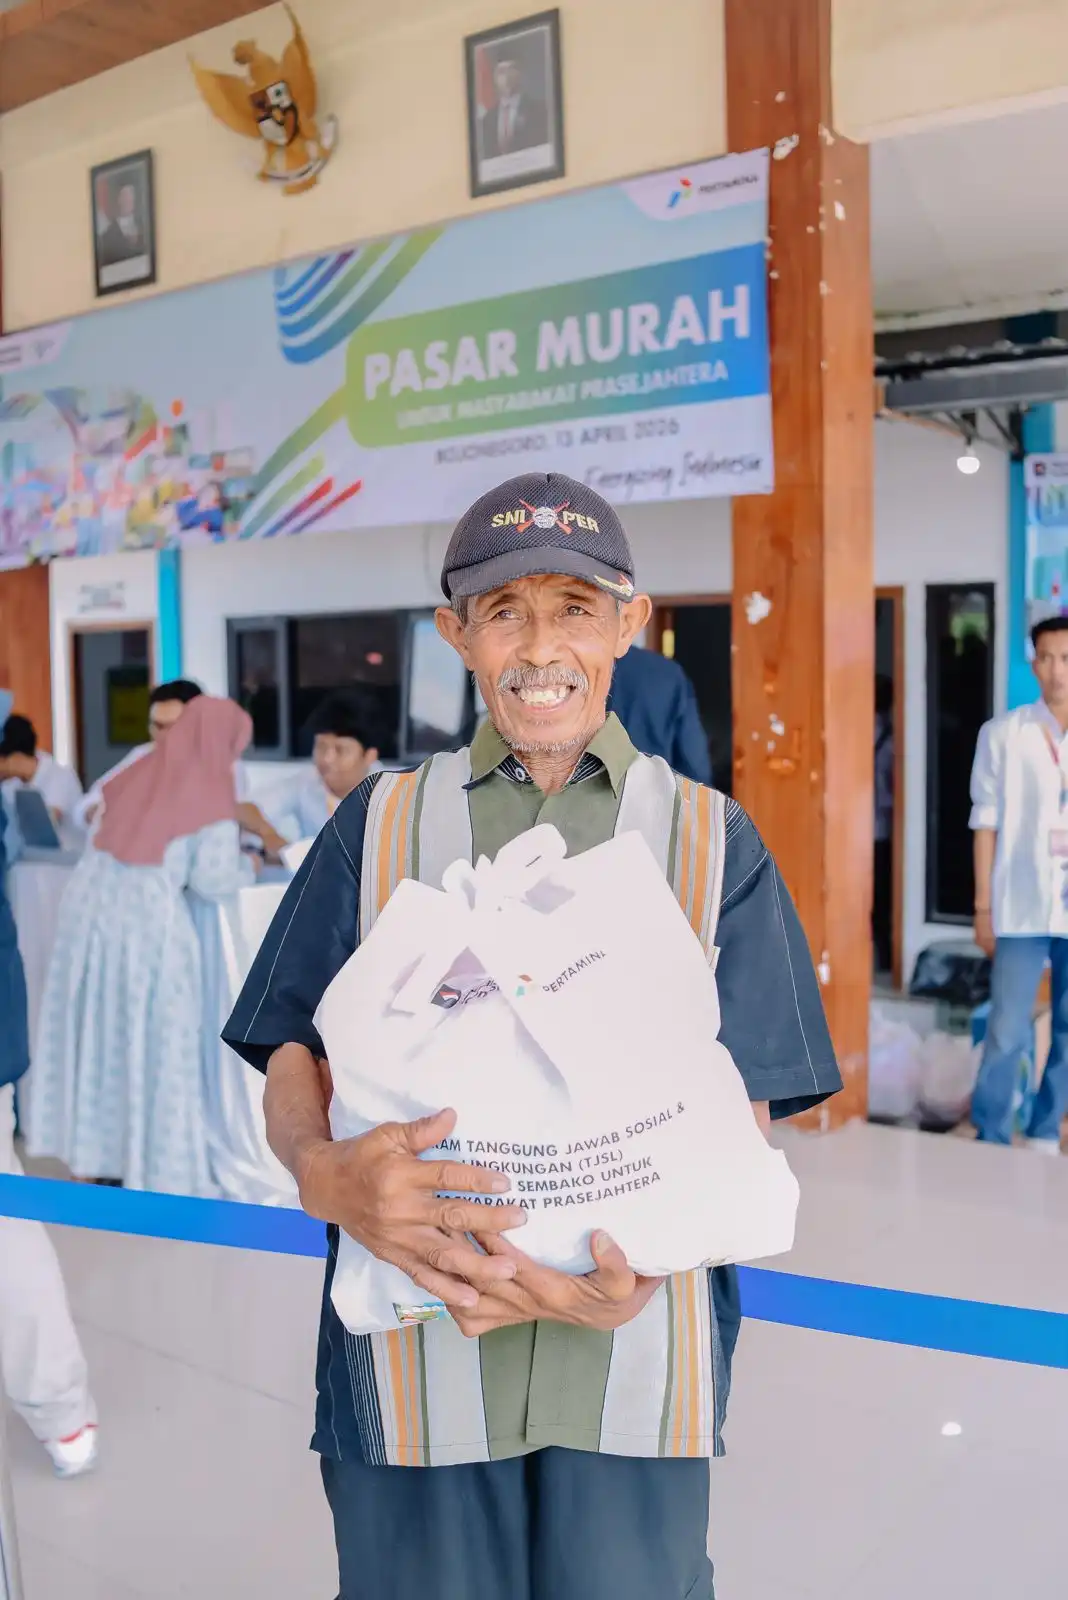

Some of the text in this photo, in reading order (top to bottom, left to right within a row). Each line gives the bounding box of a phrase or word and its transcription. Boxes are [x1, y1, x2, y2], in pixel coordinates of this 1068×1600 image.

[364, 284, 750, 402] PASAR MURAH
[579, 359, 729, 399] PRASEJAHTERA
[579, 425, 627, 444] APRIL
[491, 509, 600, 533] SNI PER
[466, 1139, 559, 1157] TANGGUNG
[565, 1131, 621, 1155] JAWAB
[624, 1108, 674, 1139] SOSIAL
[676, 1101, 686, 1114] &
[517, 1156, 653, 1193] SEMBAKO UNTUK
[578, 1149, 625, 1172] (TJSL)
[543, 1171, 661, 1209] PRASEJAHTERA
